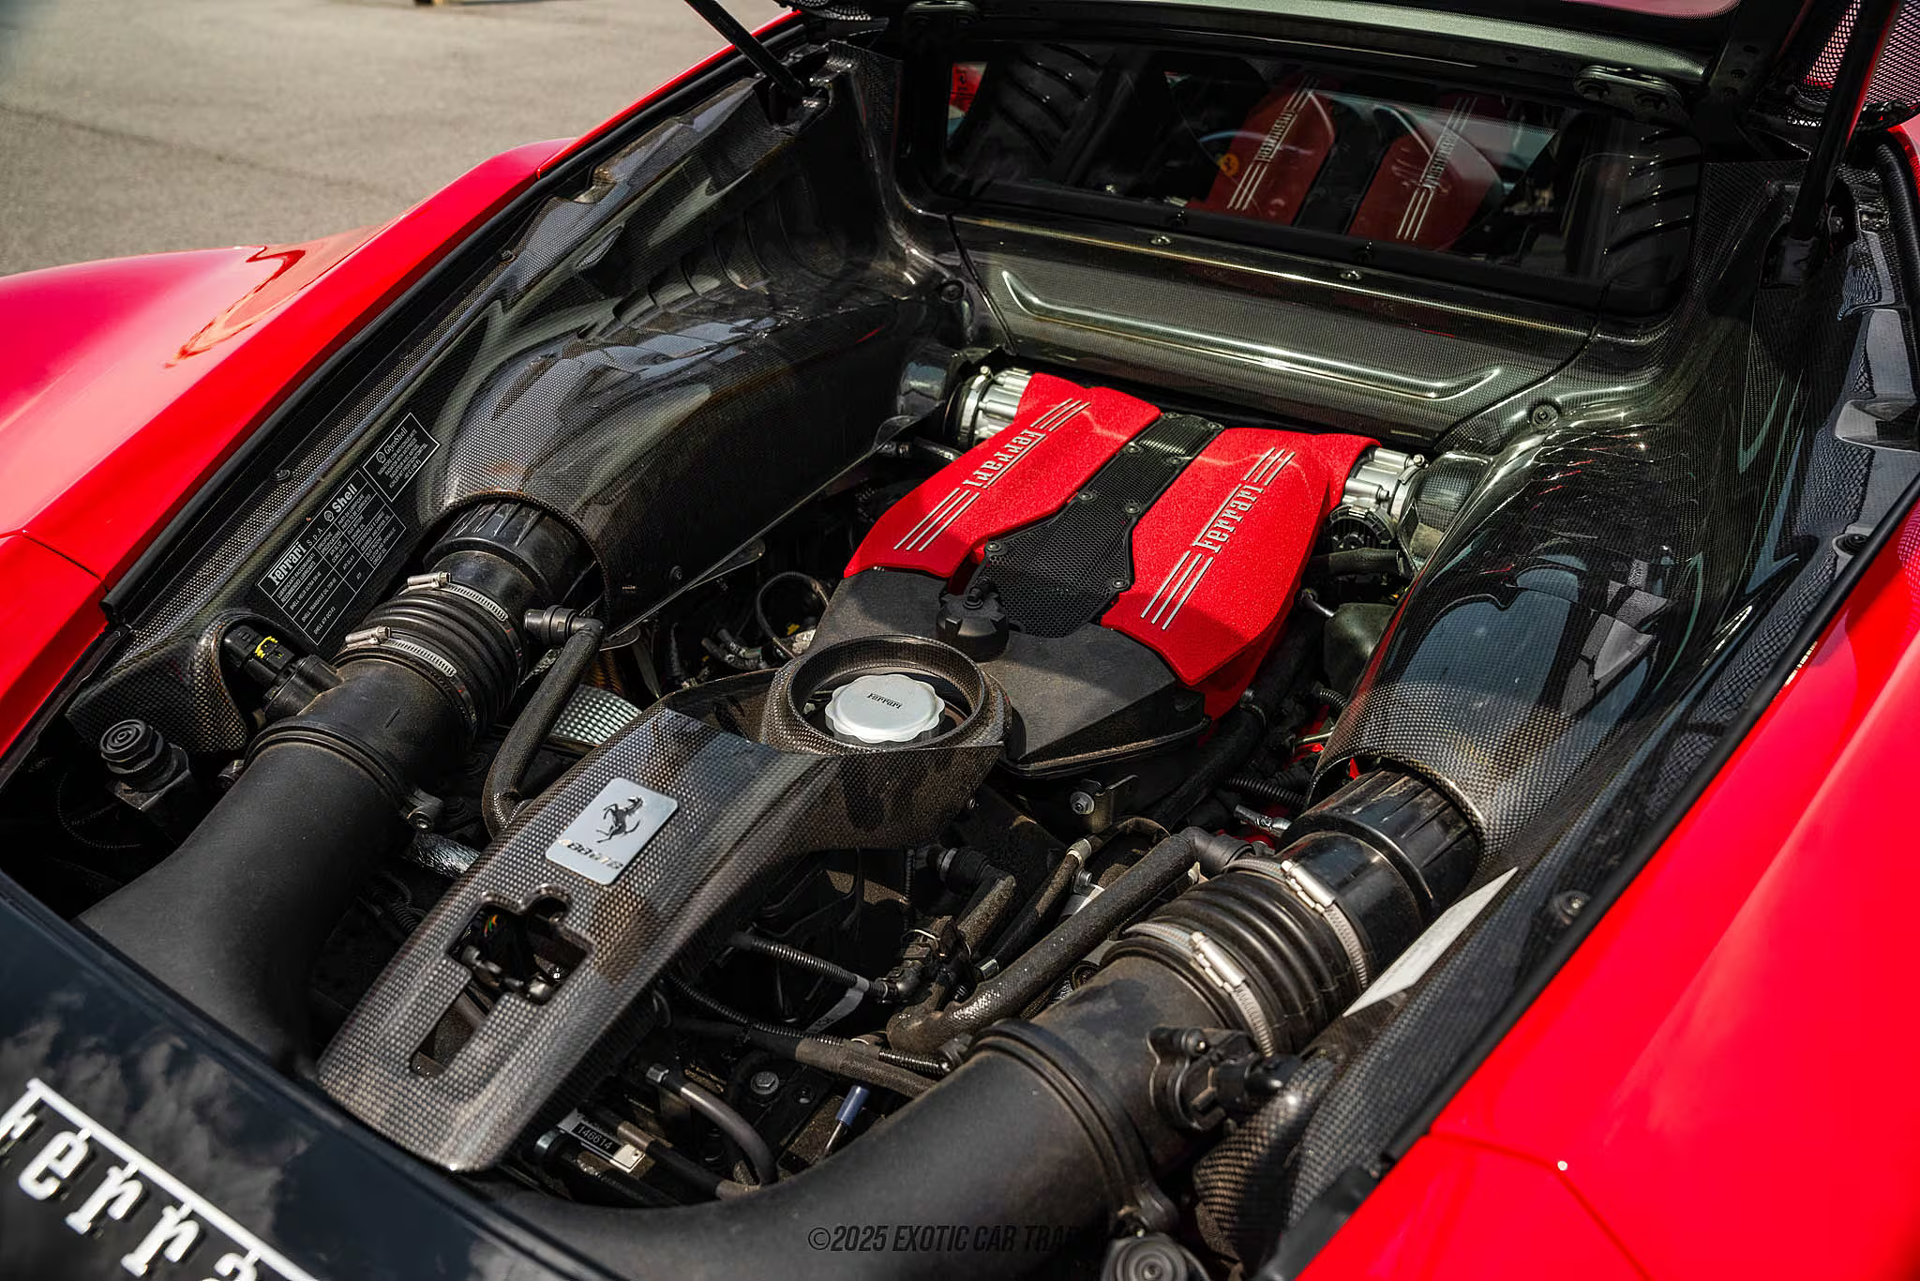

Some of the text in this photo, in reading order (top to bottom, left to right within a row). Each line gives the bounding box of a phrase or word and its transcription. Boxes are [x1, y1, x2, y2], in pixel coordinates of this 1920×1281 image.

[962, 429, 1046, 489] Ferrari
[332, 483, 358, 513] Shell
[1192, 484, 1263, 553] Ferrari
[268, 540, 307, 586] Ferrari
[866, 693, 904, 709] Ferrari
[576, 1126, 613, 1150] 146614
[0, 1077, 318, 1281] Ferr
